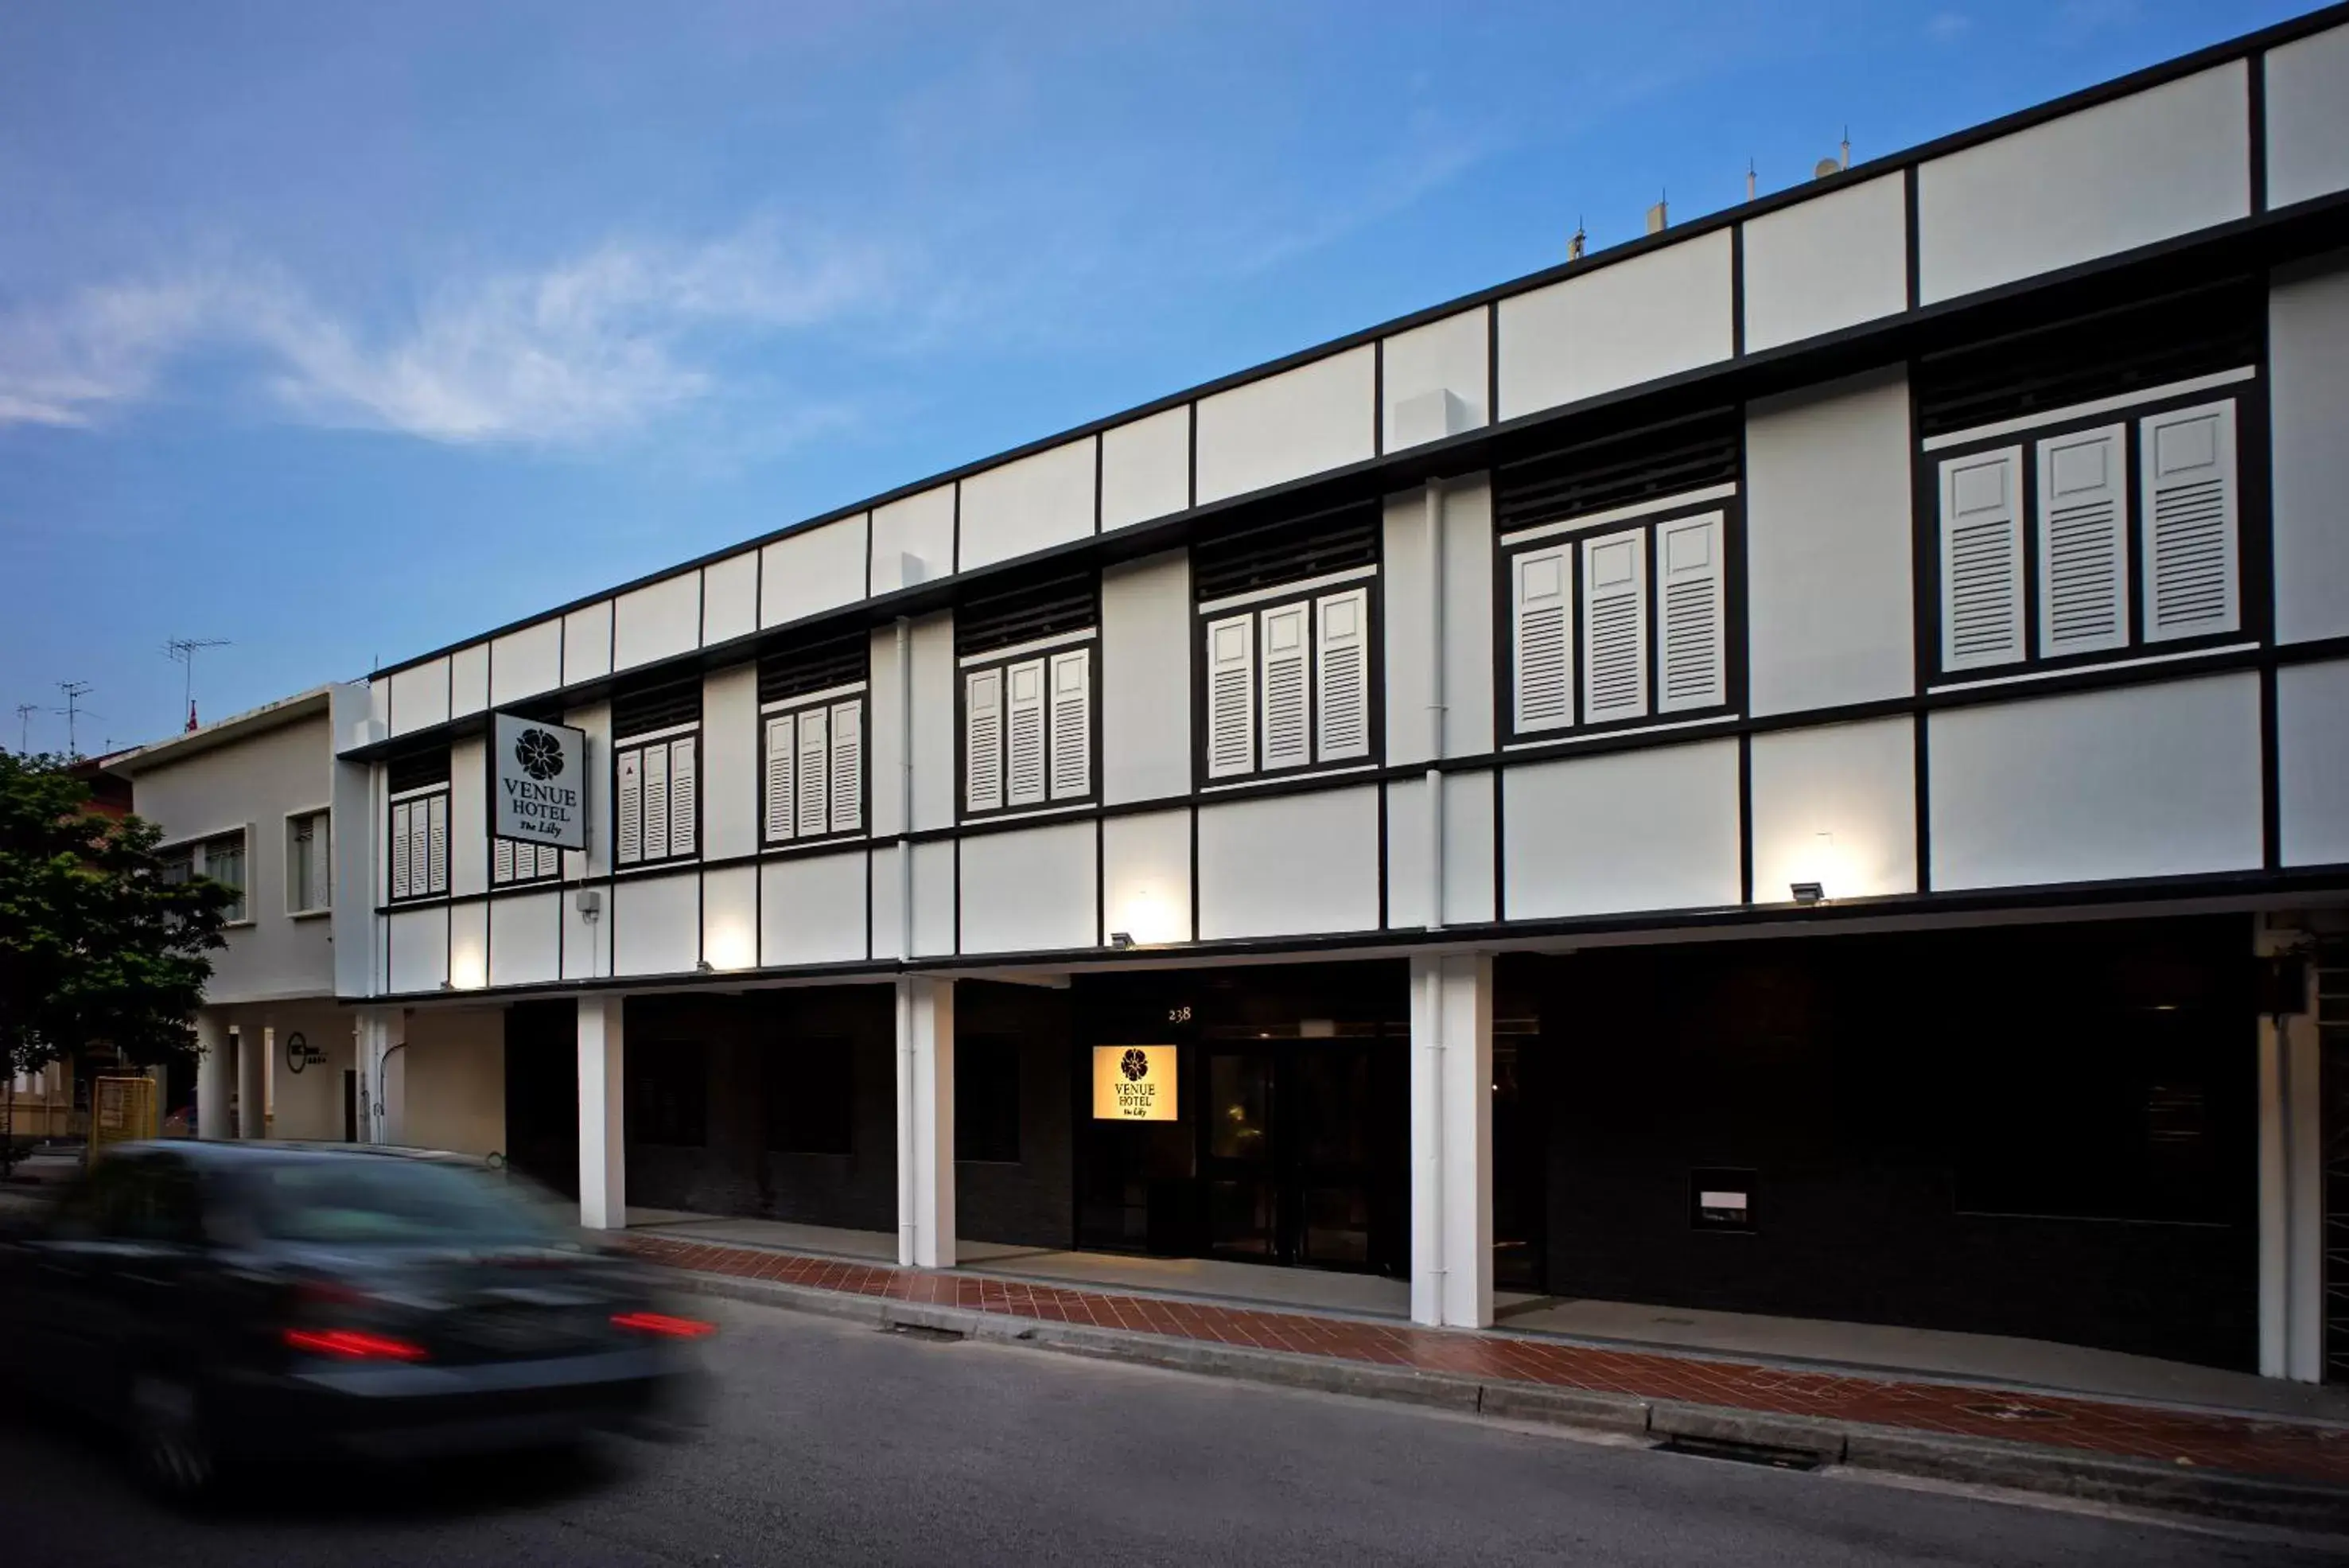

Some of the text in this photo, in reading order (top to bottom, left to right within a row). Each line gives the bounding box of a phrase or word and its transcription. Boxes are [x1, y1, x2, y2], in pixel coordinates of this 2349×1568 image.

[504, 778, 576, 807] VENUE
[512, 800, 570, 821] HOTEL
[519, 821, 562, 838] The Lily
[1169, 1006, 1191, 1023] 238
[1115, 1084, 1155, 1095] VENUE
[1119, 1096, 1151, 1107] HOTEL
[1134, 1107, 1147, 1118] Lily
